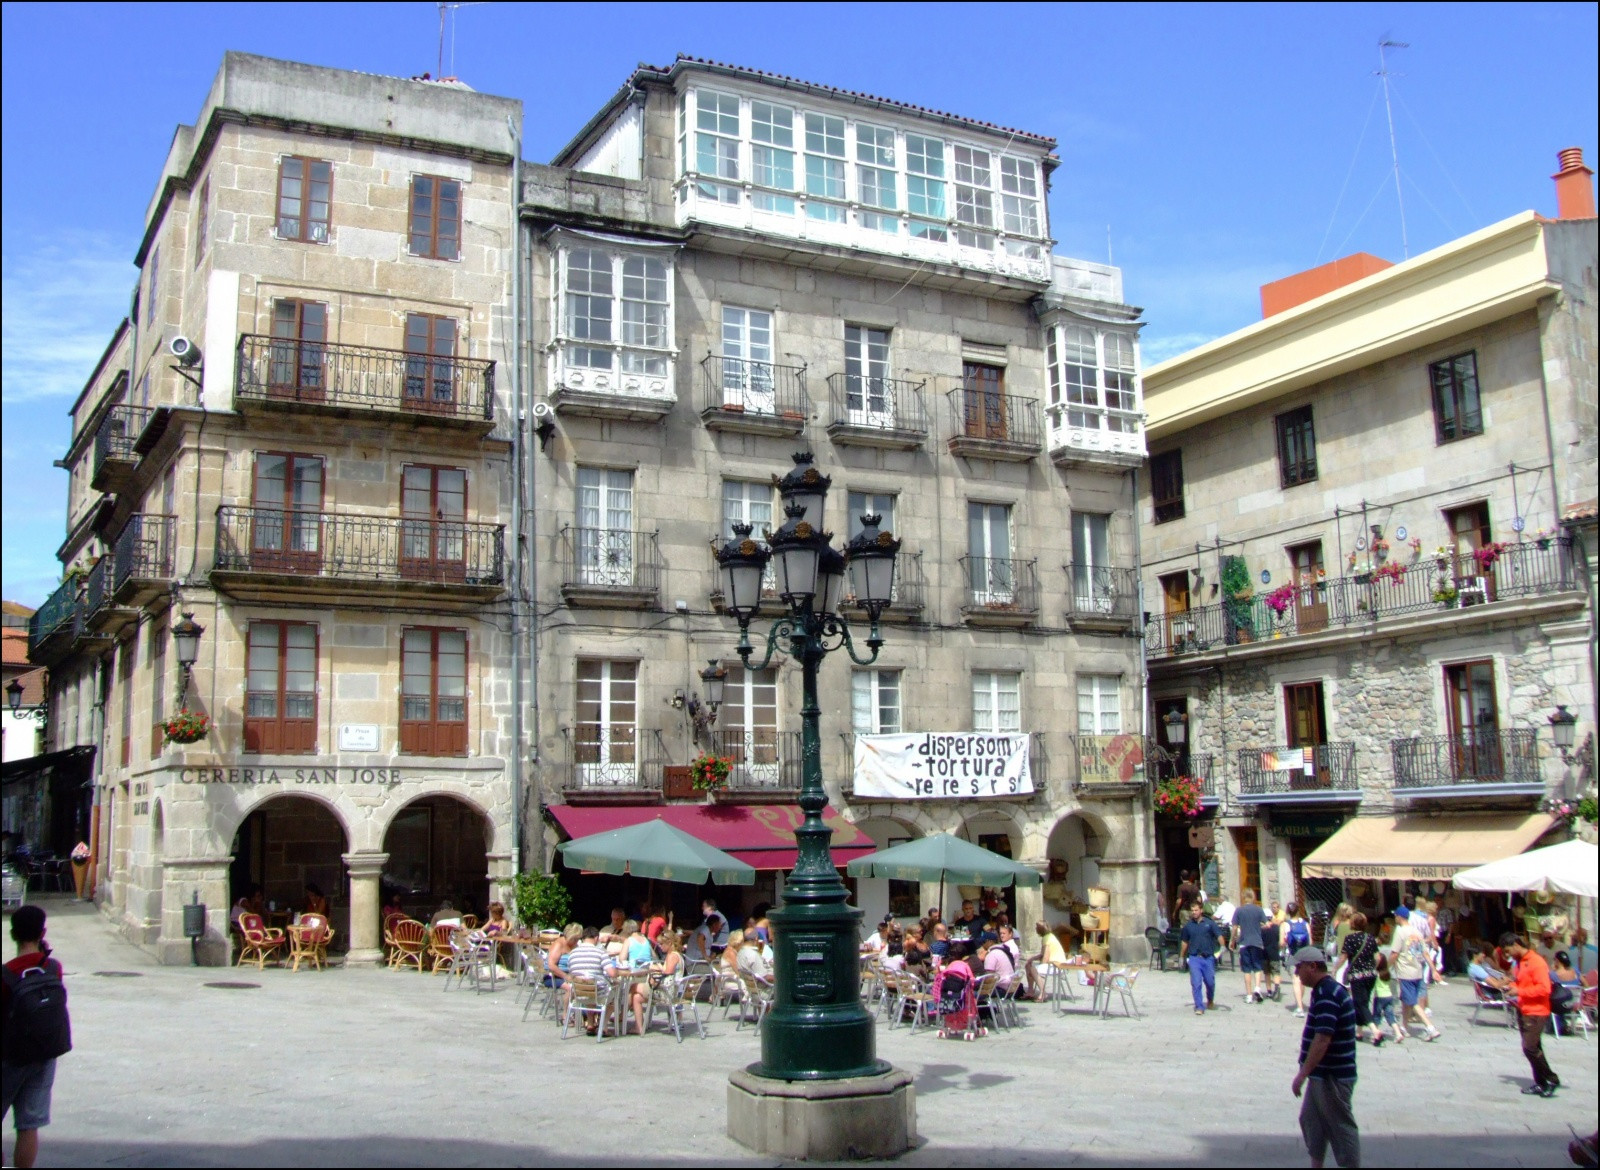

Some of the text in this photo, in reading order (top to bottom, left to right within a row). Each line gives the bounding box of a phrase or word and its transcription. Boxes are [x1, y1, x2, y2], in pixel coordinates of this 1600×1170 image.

[925, 757, 1006, 777] tortura
[180, 769, 401, 784] CERERIA SAN JOSE
[1343, 866, 1387, 877] CESTERIA
[1411, 866, 1438, 878] MARI
